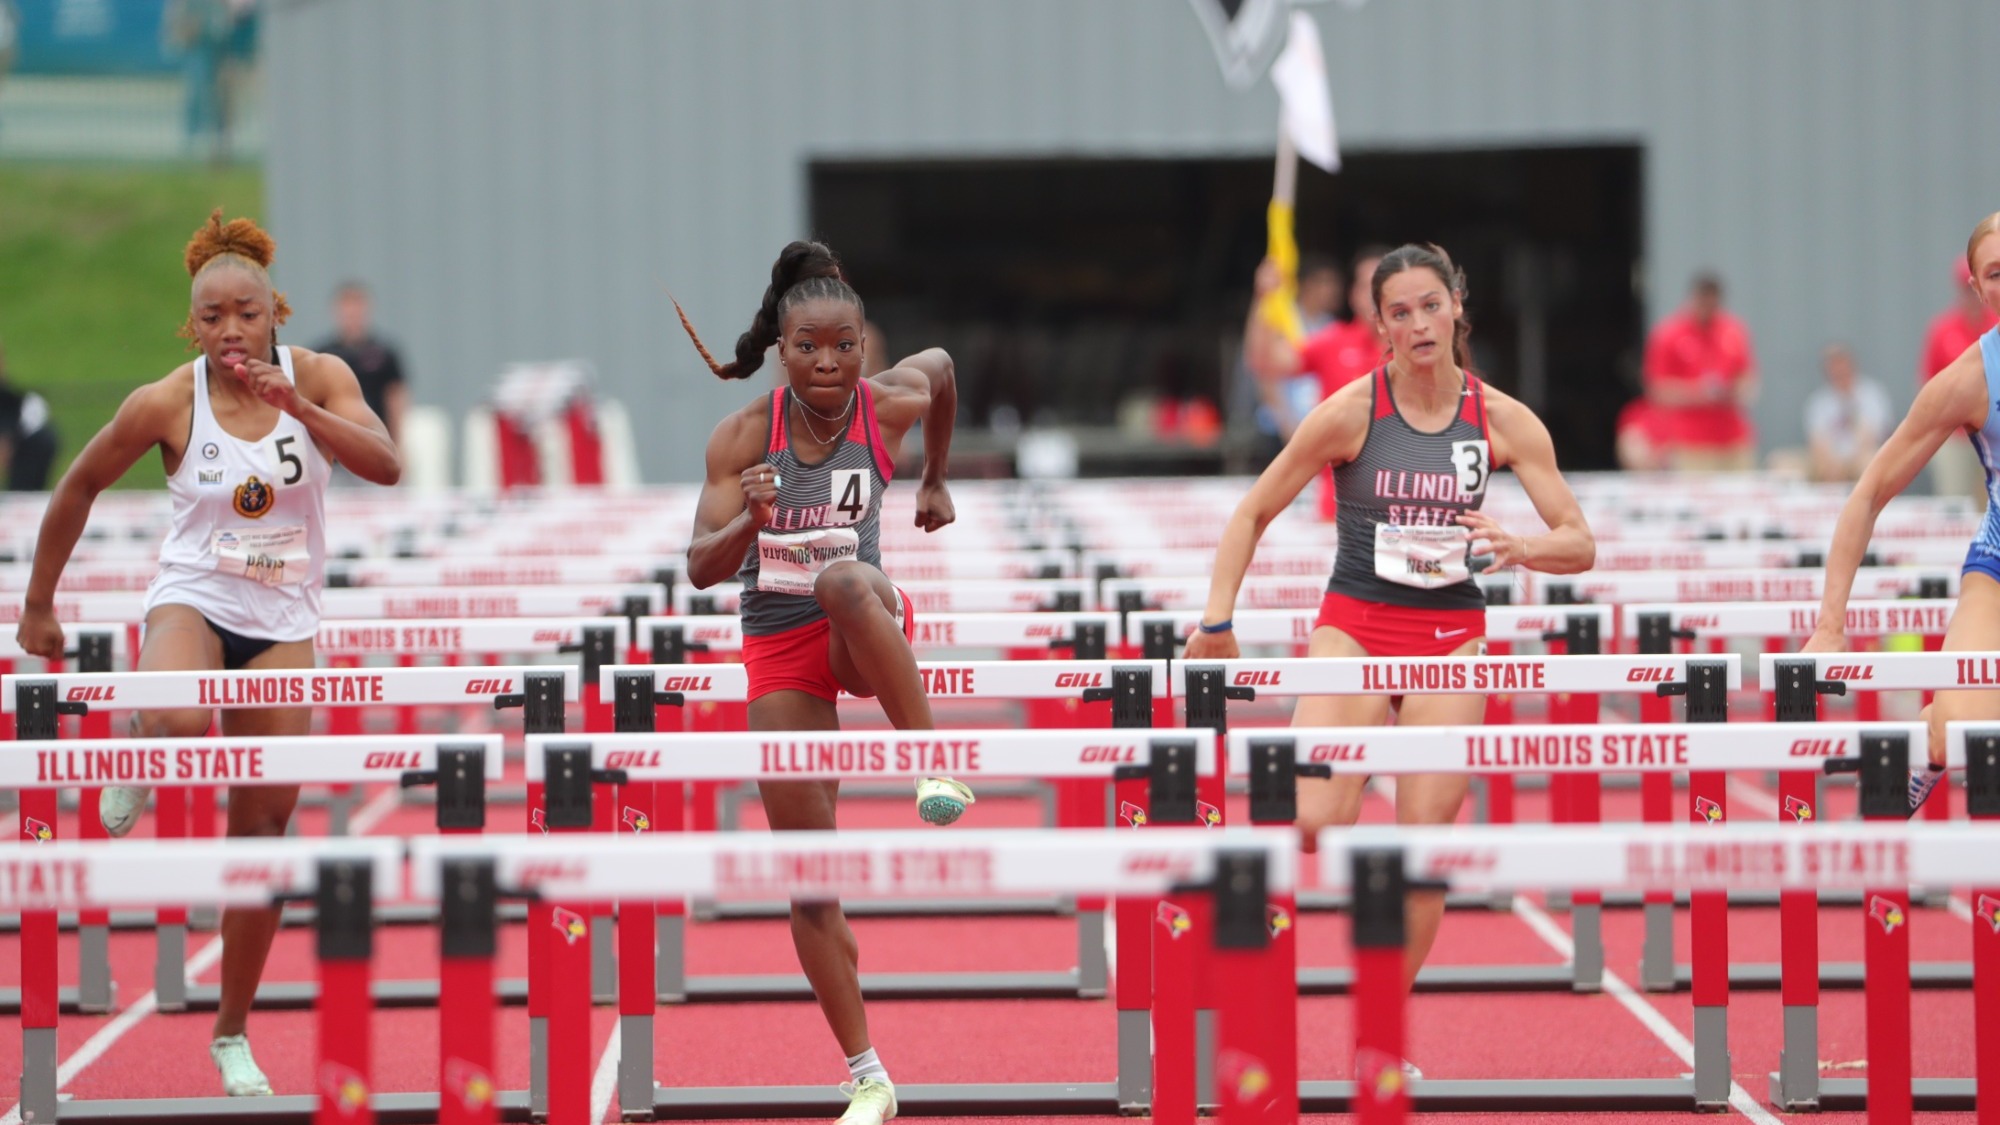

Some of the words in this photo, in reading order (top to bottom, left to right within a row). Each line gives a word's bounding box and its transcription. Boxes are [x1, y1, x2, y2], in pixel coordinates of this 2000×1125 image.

[274, 434, 304, 486] 5
[1461, 444, 1483, 493] 3
[836, 472, 864, 521] 4
[1374, 470, 1474, 504] ILLINOI
[765, 504, 848, 530] LLINO
[246, 553, 285, 568] DAVIS
[1405, 556, 1442, 574] NESS
[1790, 608, 1881, 632] ILLOIS
[1886, 607, 1946, 630] STATE
[316, 628, 396, 650] LLINOIS
[402, 626, 462, 649] STATE
[913, 622, 955, 644] TATE
[664, 675, 713, 692] GILL
[919, 668, 975, 694] TATE
[1055, 672, 1103, 688] GILL
[1233, 670, 1281, 686] GILL
[1363, 663, 1466, 690] ILLINOIS
[1474, 662, 1545, 689] STATE
[1626, 667, 1675, 683] GILL
[1824, 665, 1874, 682] GILL
[66, 685, 116, 702] GILL
[199, 677, 304, 705] ILLINOIS
[312, 675, 384, 703] STATE
[464, 678, 514, 695] GILL
[760, 742, 886, 773] ILLINOIS
[895, 740, 981, 771] STATE
[1078, 745, 1136, 764] GILL
[1309, 744, 1367, 762] GILL
[1466, 736, 1592, 767] ILLINOIS
[1601, 734, 1689, 765] STATE
[1788, 739, 1848, 757] GILL
[37, 749, 167, 782] ILLINOIS
[175, 747, 264, 780] STATE
[363, 751, 424, 770] GILL
[604, 750, 662, 769] GILL
